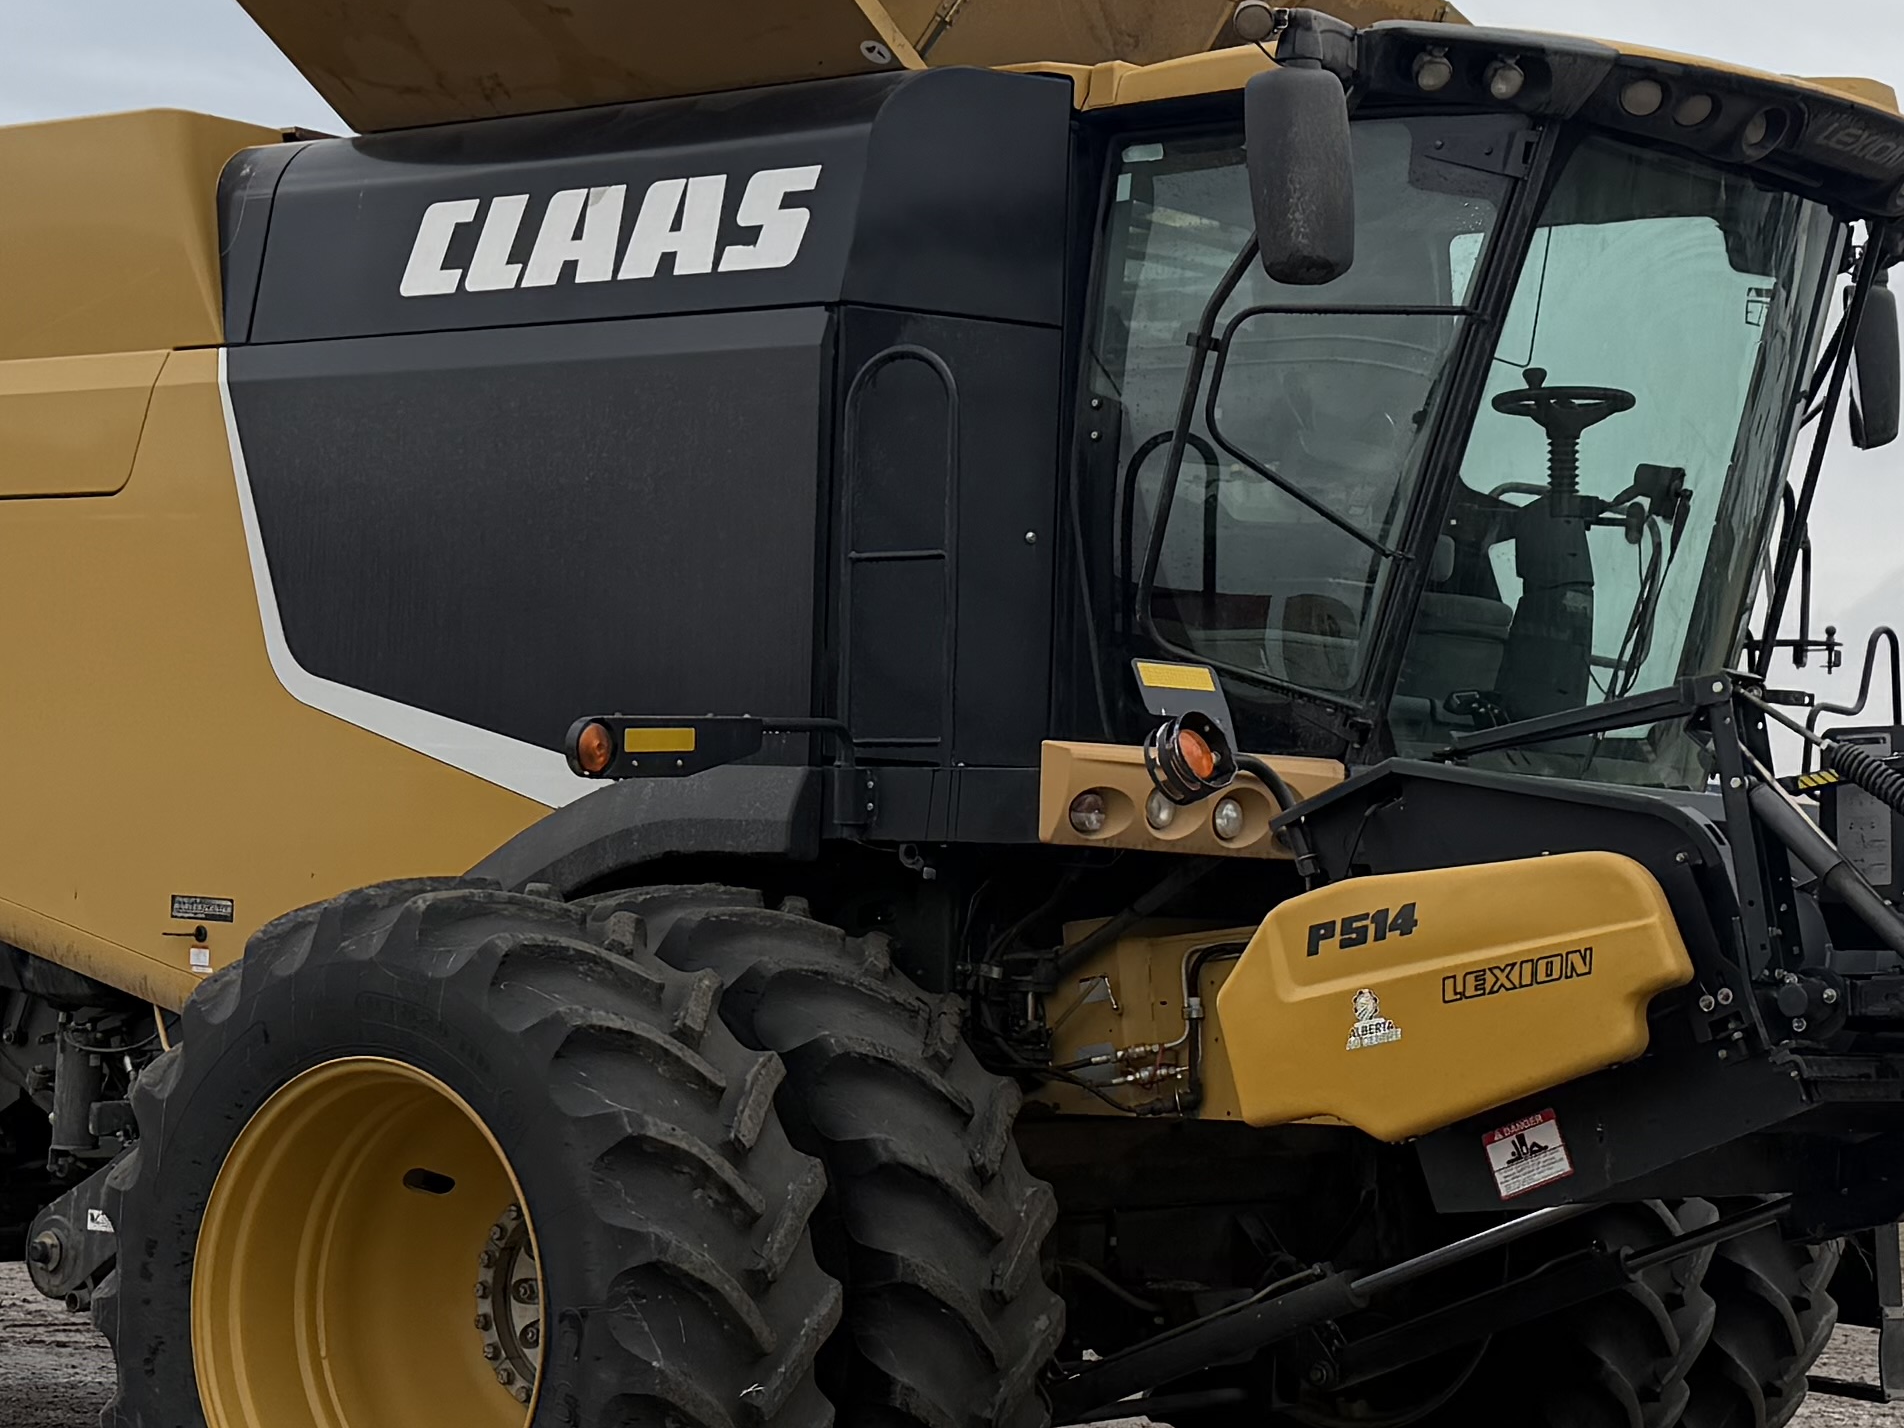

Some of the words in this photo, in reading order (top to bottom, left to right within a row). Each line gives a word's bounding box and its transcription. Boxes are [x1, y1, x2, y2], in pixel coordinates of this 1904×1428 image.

[399, 164, 823, 297] CLAAS
[1306, 902, 1418, 957] P514
[1442, 947, 1593, 1004] LEXION
[1348, 1019, 1394, 1039] ALBERTA
[1503, 1114, 1544, 1136] DANGER
